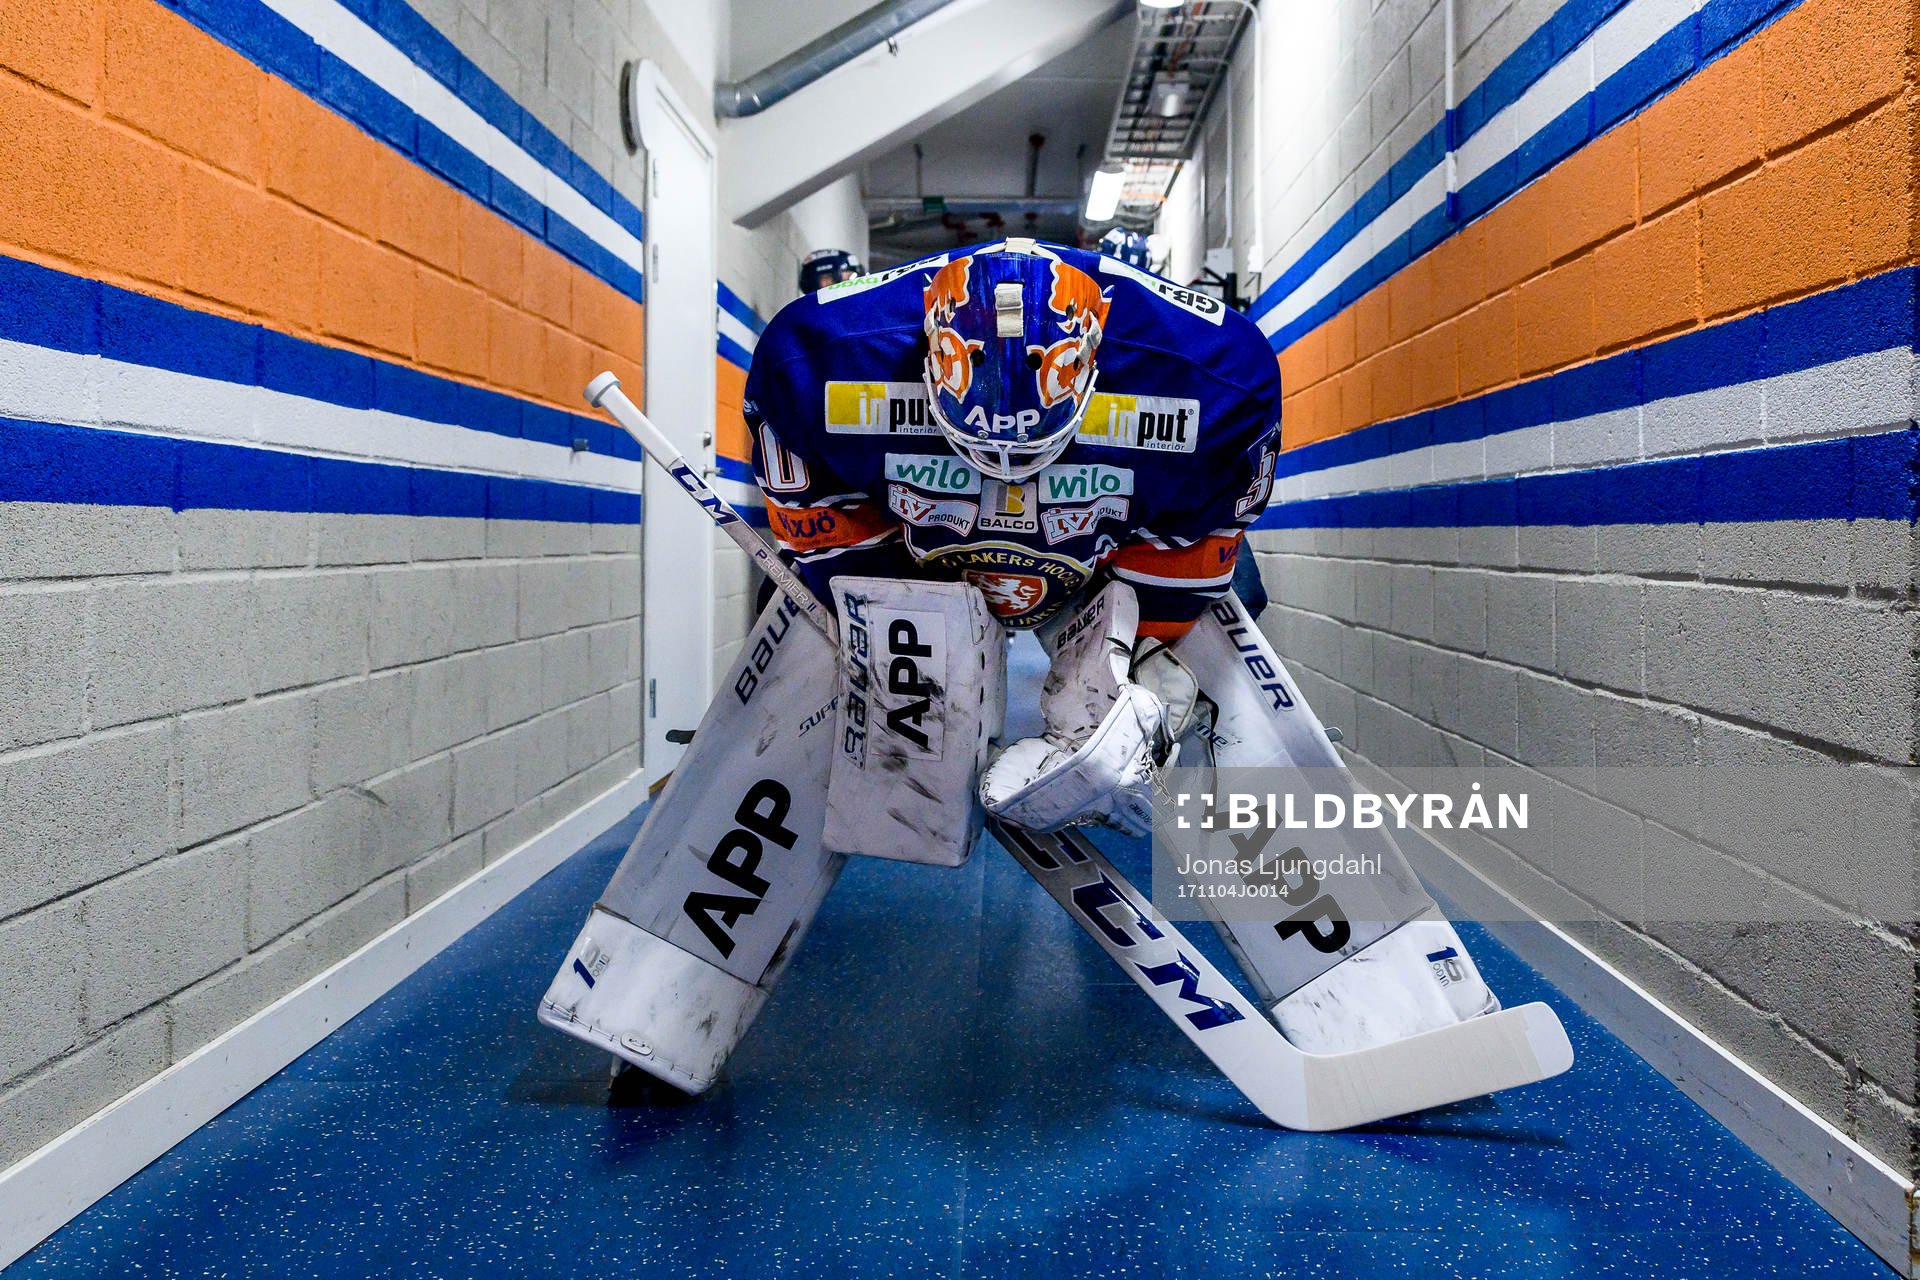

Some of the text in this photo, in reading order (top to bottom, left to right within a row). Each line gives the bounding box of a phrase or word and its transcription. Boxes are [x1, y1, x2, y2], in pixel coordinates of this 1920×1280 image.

[1158, 284, 1220, 314] GBJ
[963, 406, 1041, 432] APP
[1146, 441, 1185, 451] interior
[896, 458, 971, 490] wilo
[1048, 467, 1121, 499] wilo
[928, 513, 970, 530] PRODUKT
[980, 518, 1035, 531] BALCO
[755, 549, 809, 607] PREMIER
[887, 618, 932, 750] APP
[683, 778, 799, 960] APP
[1202, 804, 1351, 954] APP
